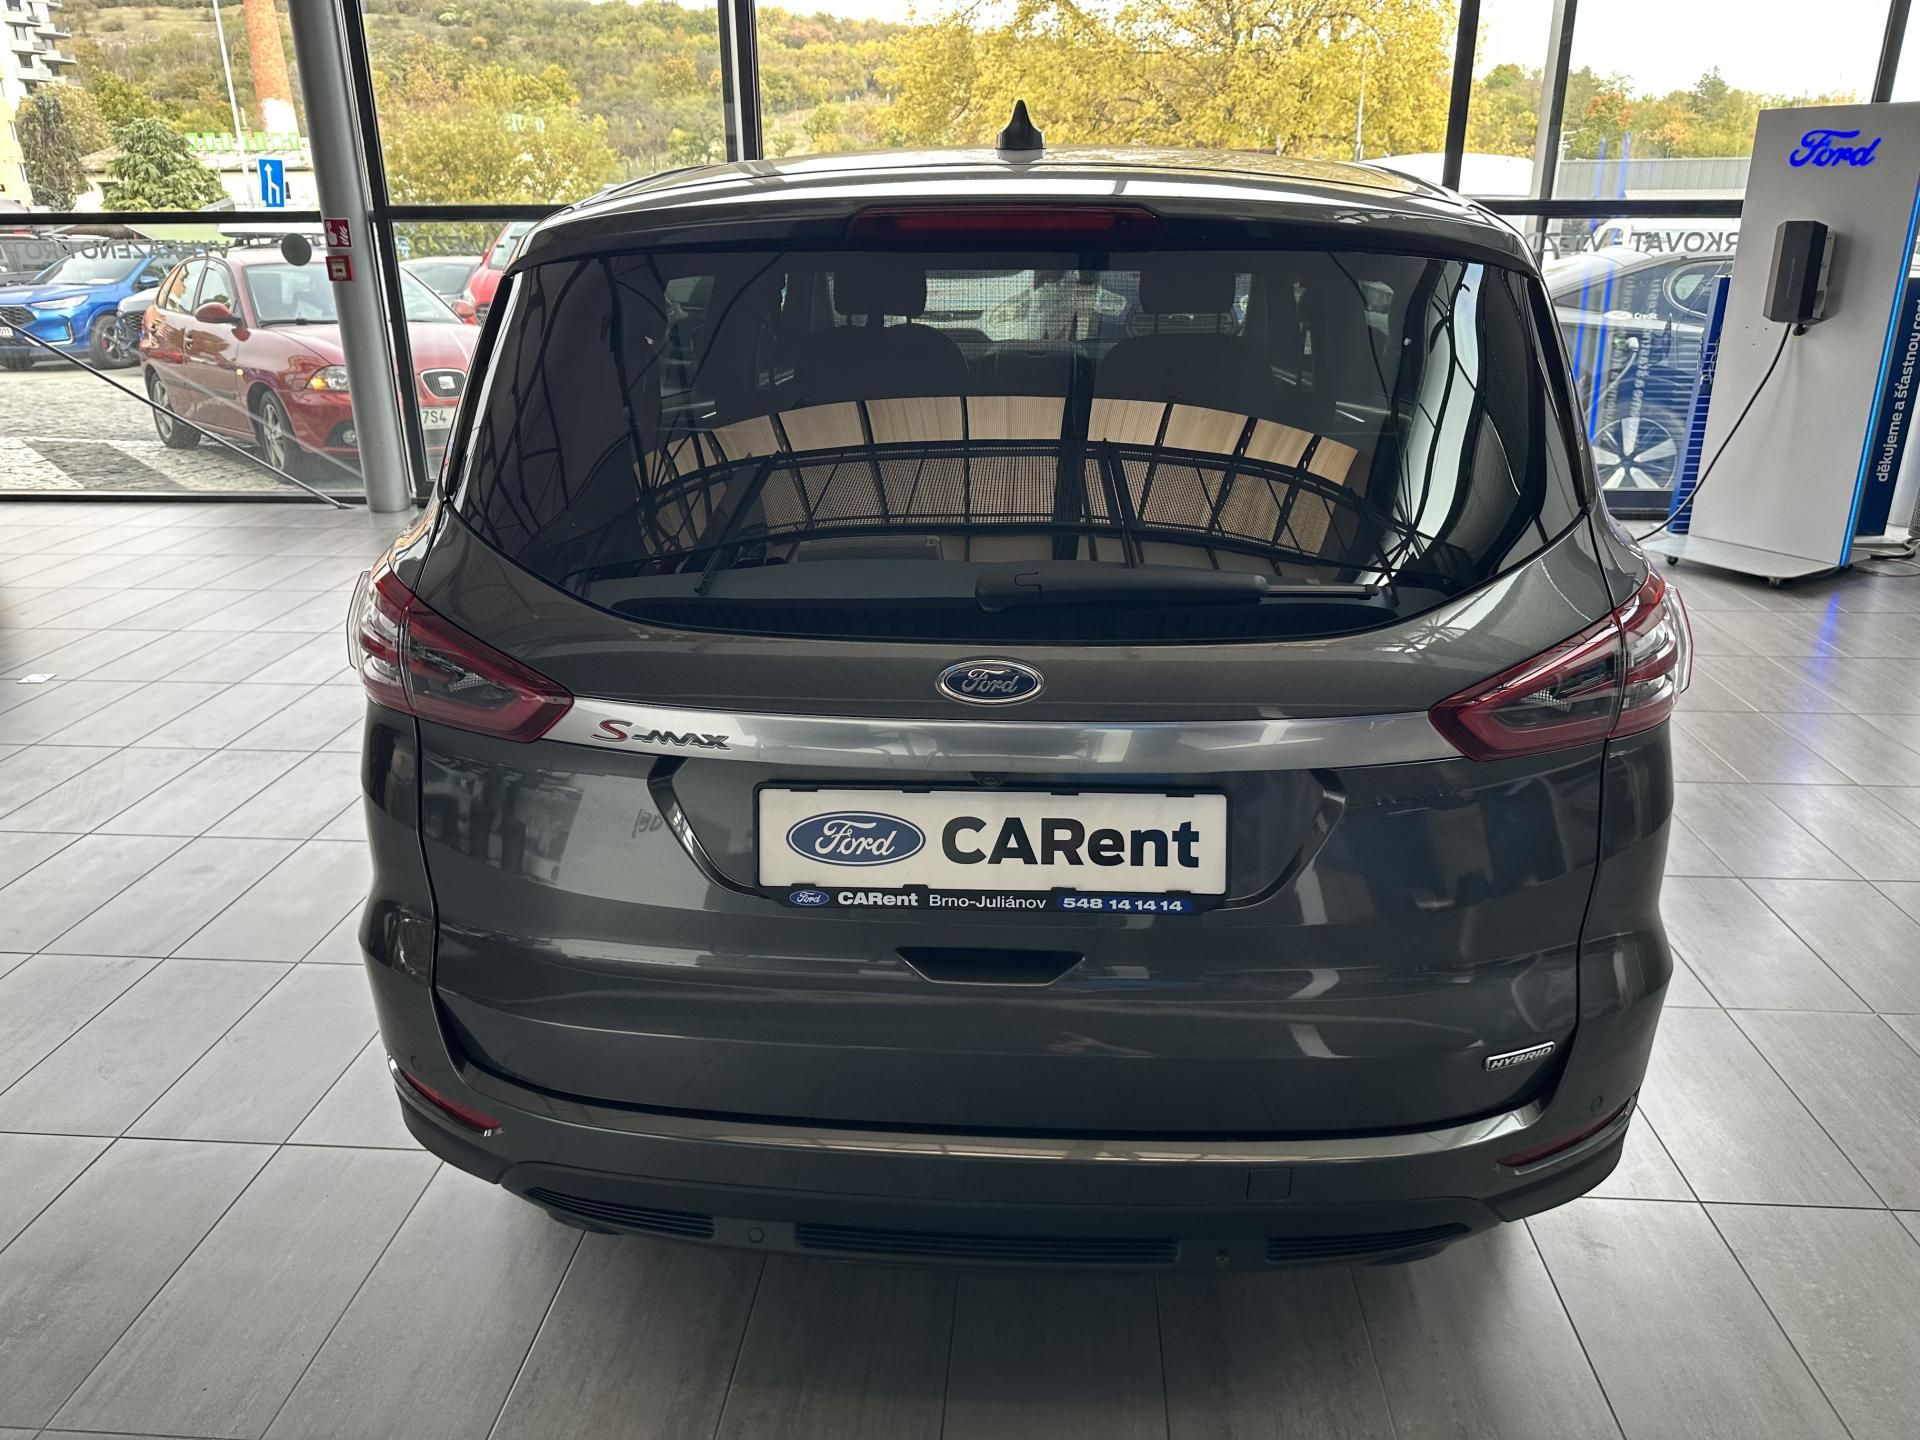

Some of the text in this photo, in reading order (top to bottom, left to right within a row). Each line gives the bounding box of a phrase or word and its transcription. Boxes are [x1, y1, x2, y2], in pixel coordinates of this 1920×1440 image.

[1789, 129, 1882, 168] Ford
[1893, 332, 1920, 398] šťastnou
[422, 410, 447, 424] 7S4
[1895, 400, 1906, 410] a
[1876, 412, 1902, 482] děkujeme
[961, 667, 1020, 693] Ford
[591, 719, 731, 750] S-MAX
[815, 816, 1199, 868] Ford CARent
[796, 891, 1183, 911] Ford CARent Brno-Juliánov 548 14 14 14
[1490, 1046, 1552, 1069] HYBRID
